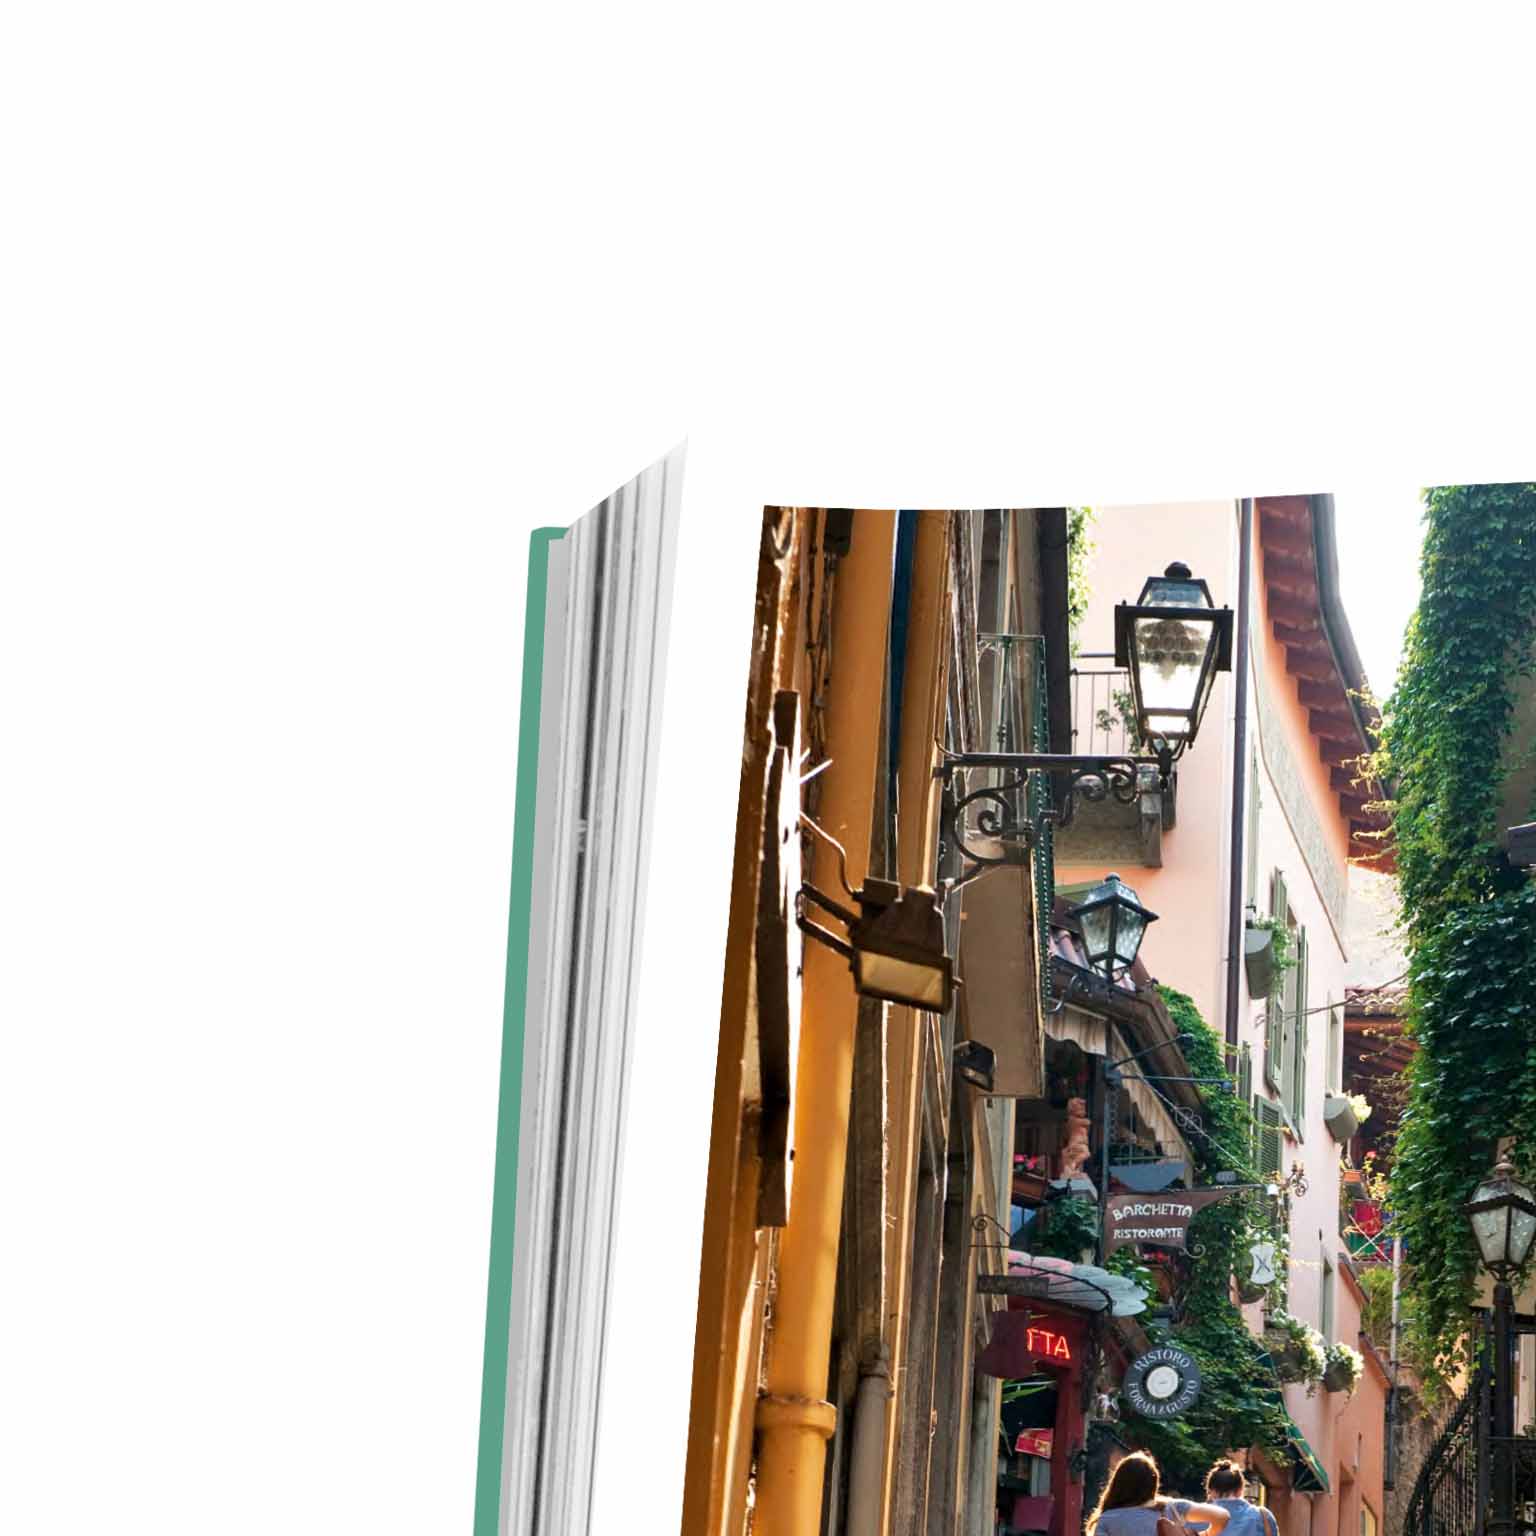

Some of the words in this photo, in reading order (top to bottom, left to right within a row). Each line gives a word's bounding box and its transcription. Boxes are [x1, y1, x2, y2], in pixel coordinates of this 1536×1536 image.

[1112, 1203, 1193, 1221] BARCHETTA
[1113, 1227, 1184, 1239] RISTORANTE
[1134, 1348, 1191, 1372] RISTORO
